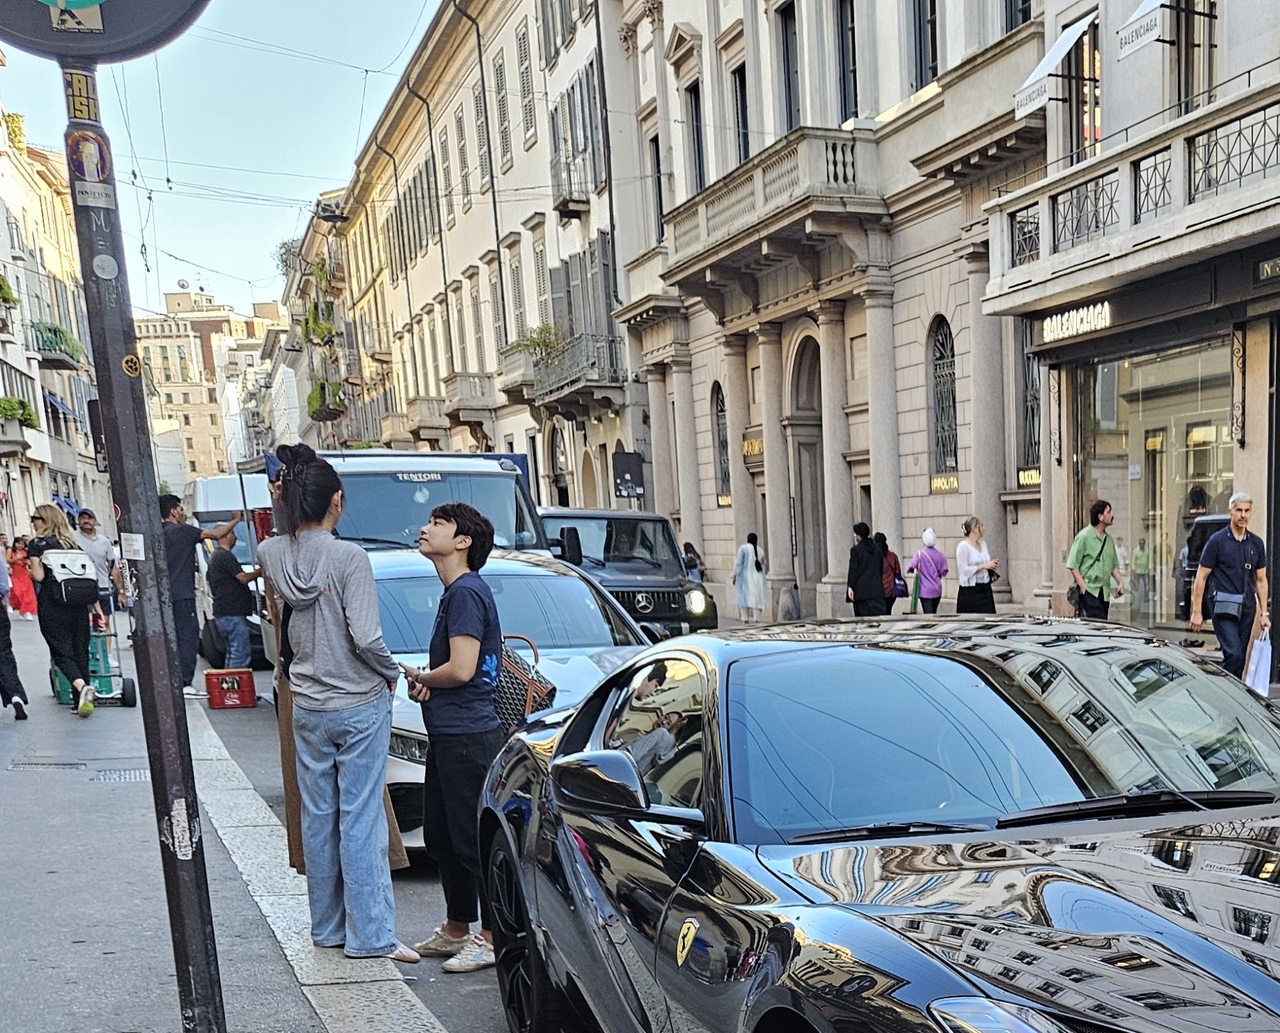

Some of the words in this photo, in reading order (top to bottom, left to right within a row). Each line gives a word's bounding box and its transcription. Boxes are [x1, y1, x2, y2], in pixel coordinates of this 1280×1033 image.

[1119, 16, 1158, 49] BALENCIAGA
[1016, 83, 1047, 111] BALENCIAGA
[1043, 300, 1111, 342] BALENCIAGA
